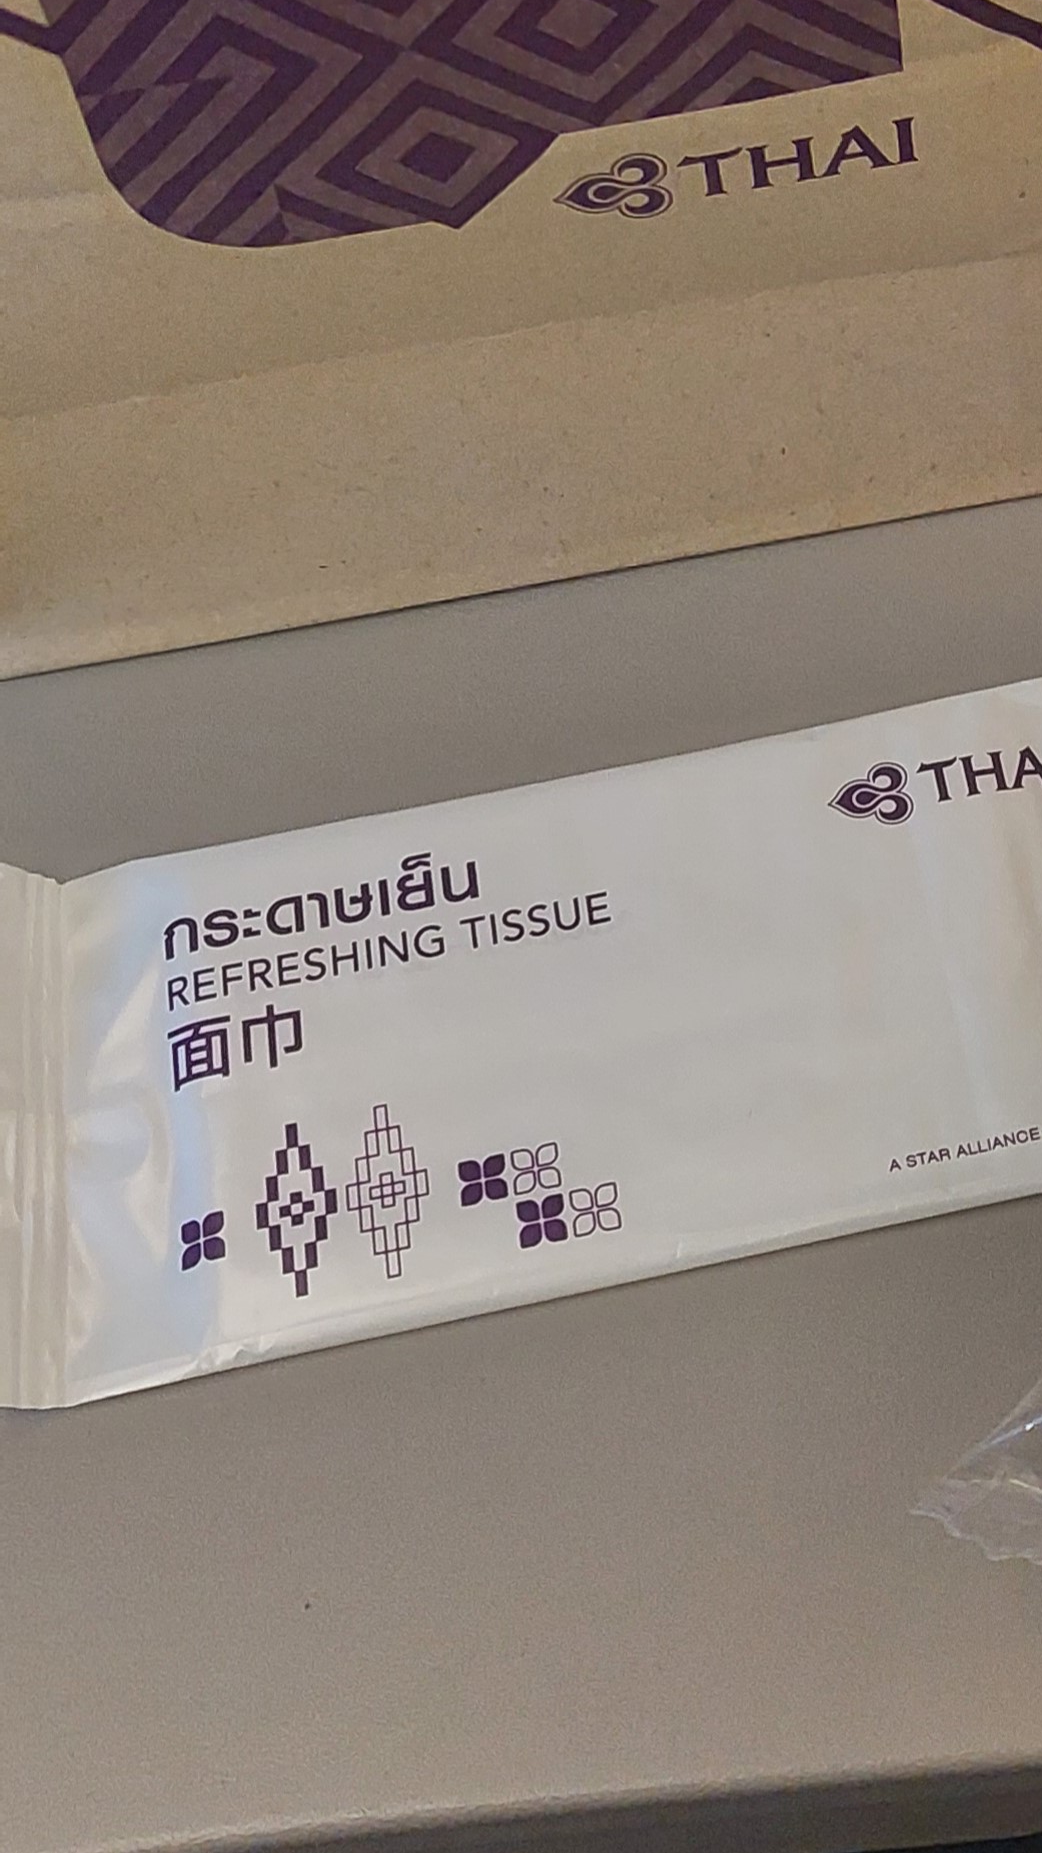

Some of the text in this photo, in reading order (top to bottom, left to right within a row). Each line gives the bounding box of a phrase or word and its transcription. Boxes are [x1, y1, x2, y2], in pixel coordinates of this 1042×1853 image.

[676, 116, 920, 198] THAI
[163, 851, 481, 960] กระดาษเย็น
[166, 891, 612, 1012] REFRESHING TISSUE
[166, 1003, 304, 1092] 面巾
[889, 1158, 902, 1173] A
[905, 1147, 951, 1168] STAR
[956, 1126, 1041, 1159] ALLIANCE
